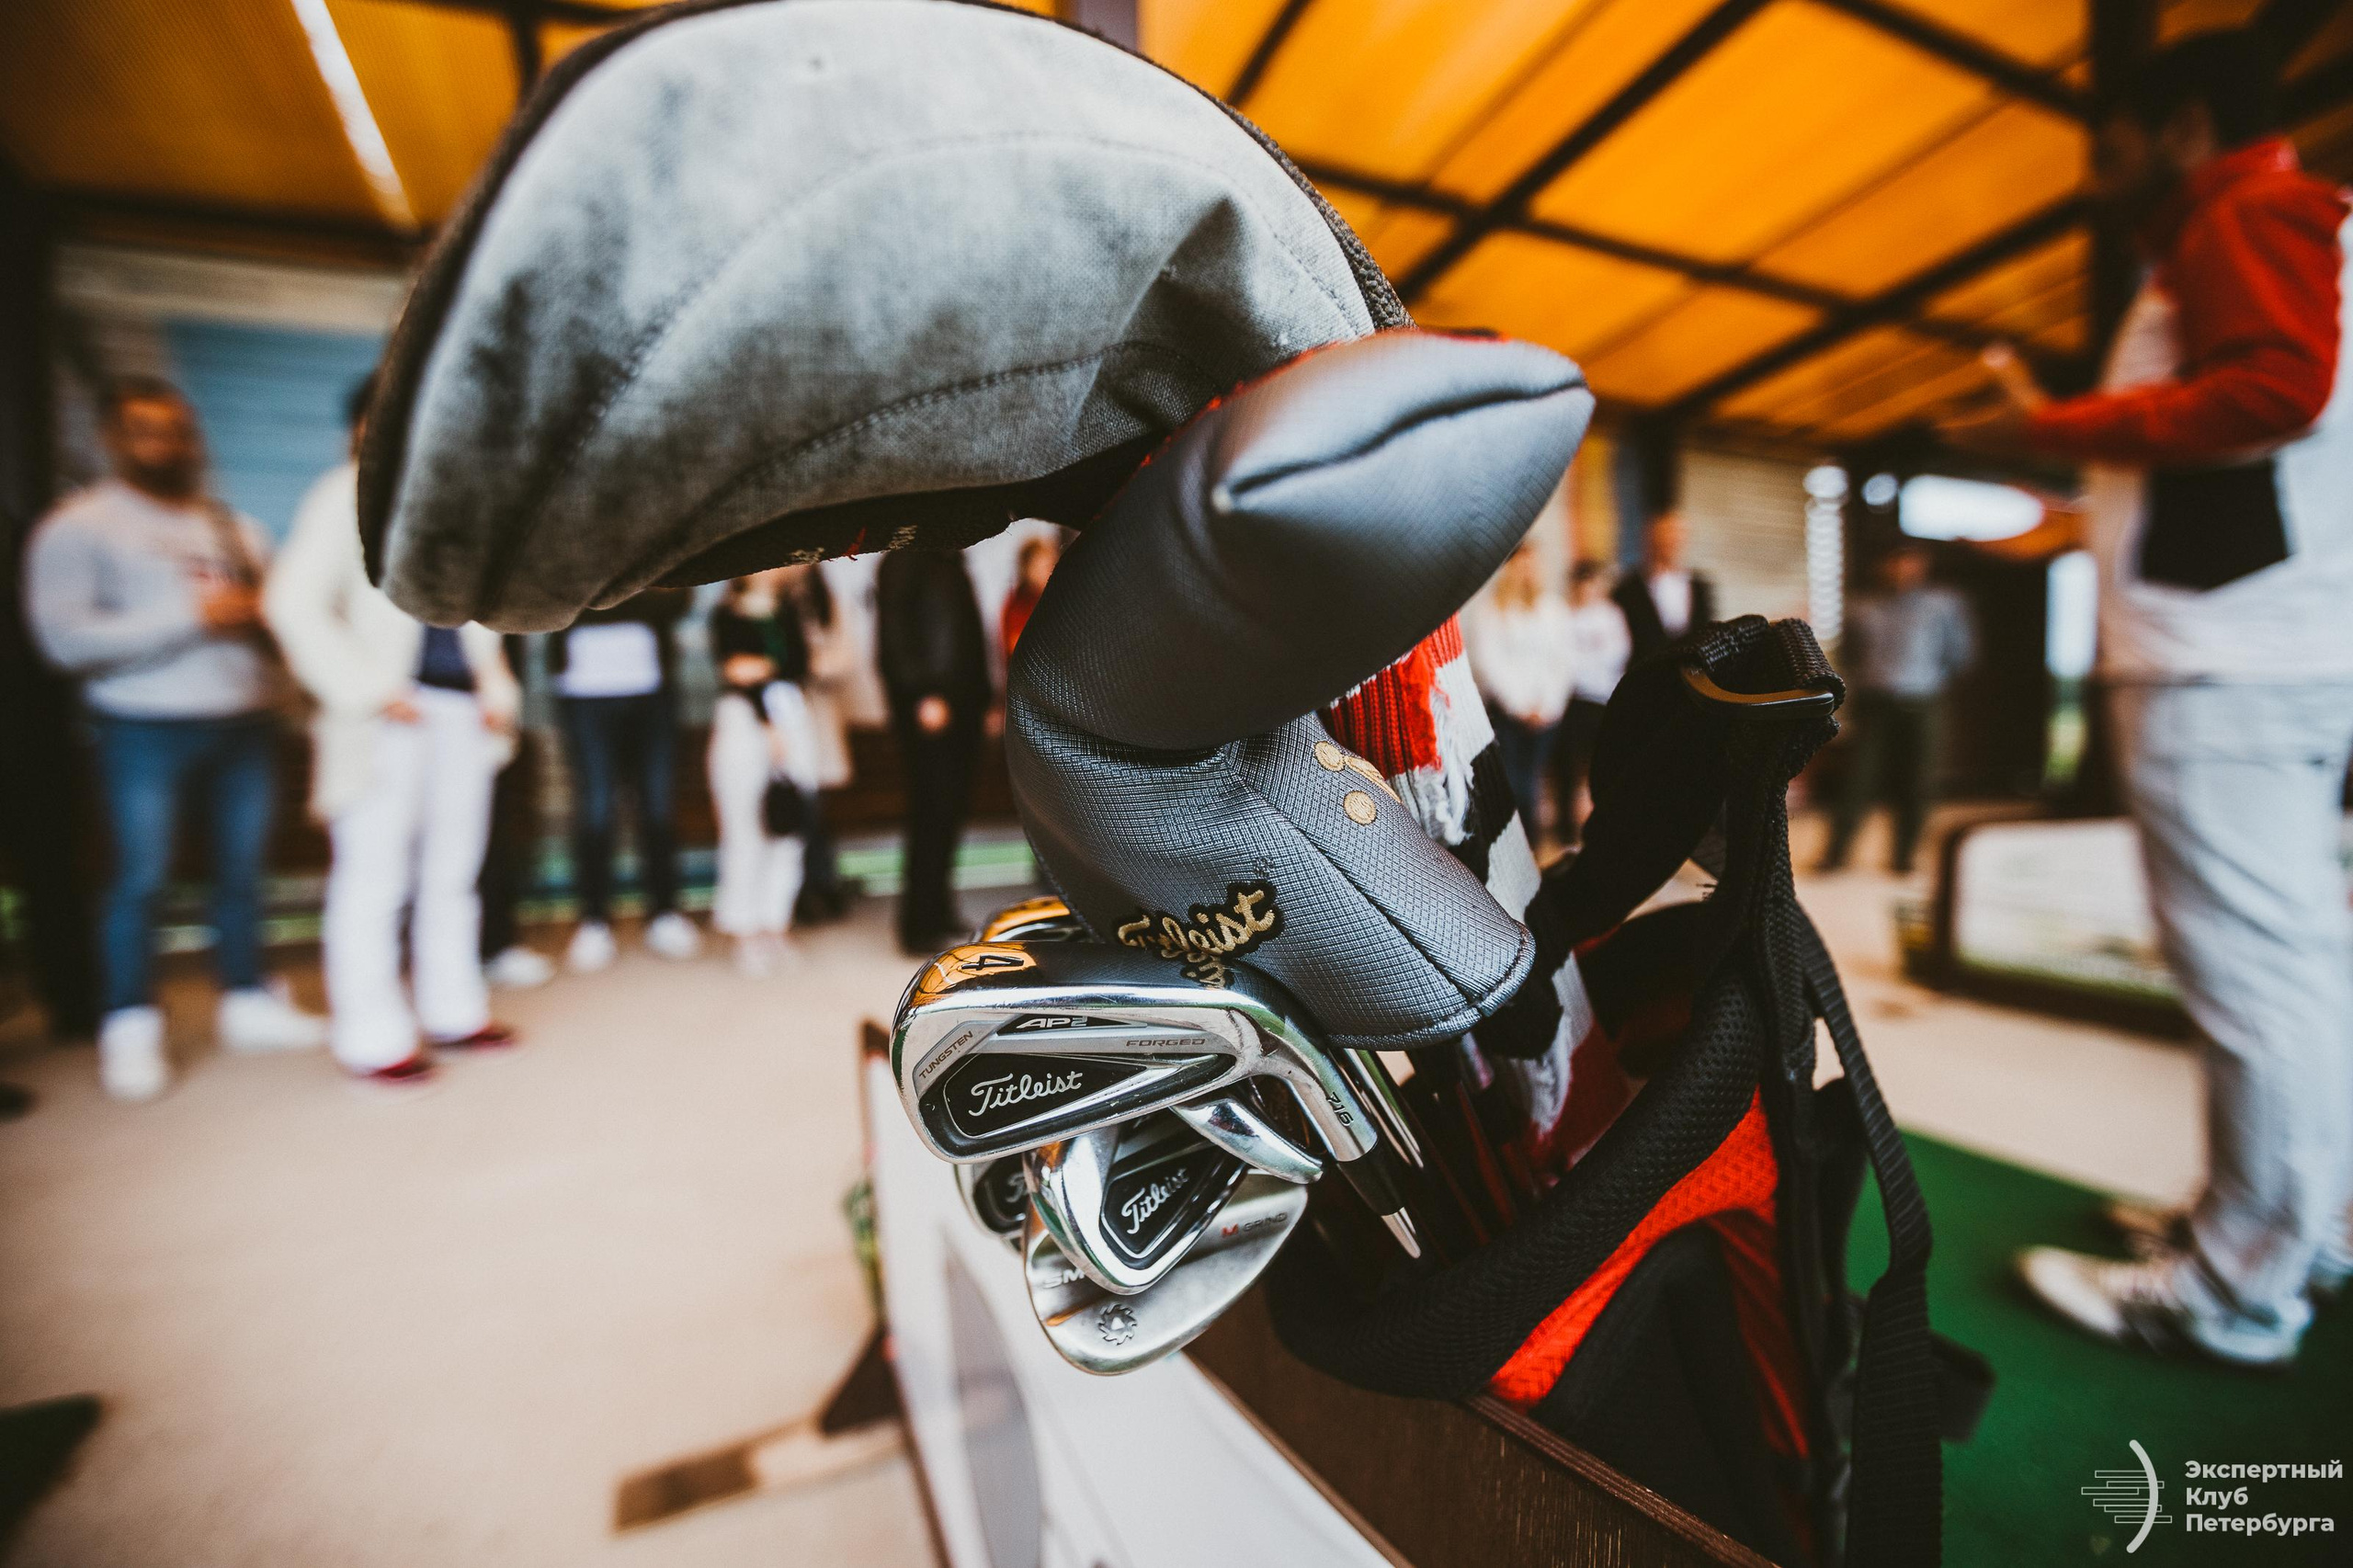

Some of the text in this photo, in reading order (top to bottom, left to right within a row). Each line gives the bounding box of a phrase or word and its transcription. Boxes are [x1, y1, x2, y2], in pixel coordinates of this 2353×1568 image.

[1118, 889, 1275, 959] Tleist
[961, 955, 1024, 971] 4
[1017, 1016, 1088, 1028] AP2
[919, 1030, 973, 1079] TUNGSTEN
[1126, 1039, 1206, 1047] FORGED
[969, 1071, 1083, 1117] Titleist
[1327, 1091, 1354, 1127] 716
[1121, 1168, 1189, 1234] Titleist
